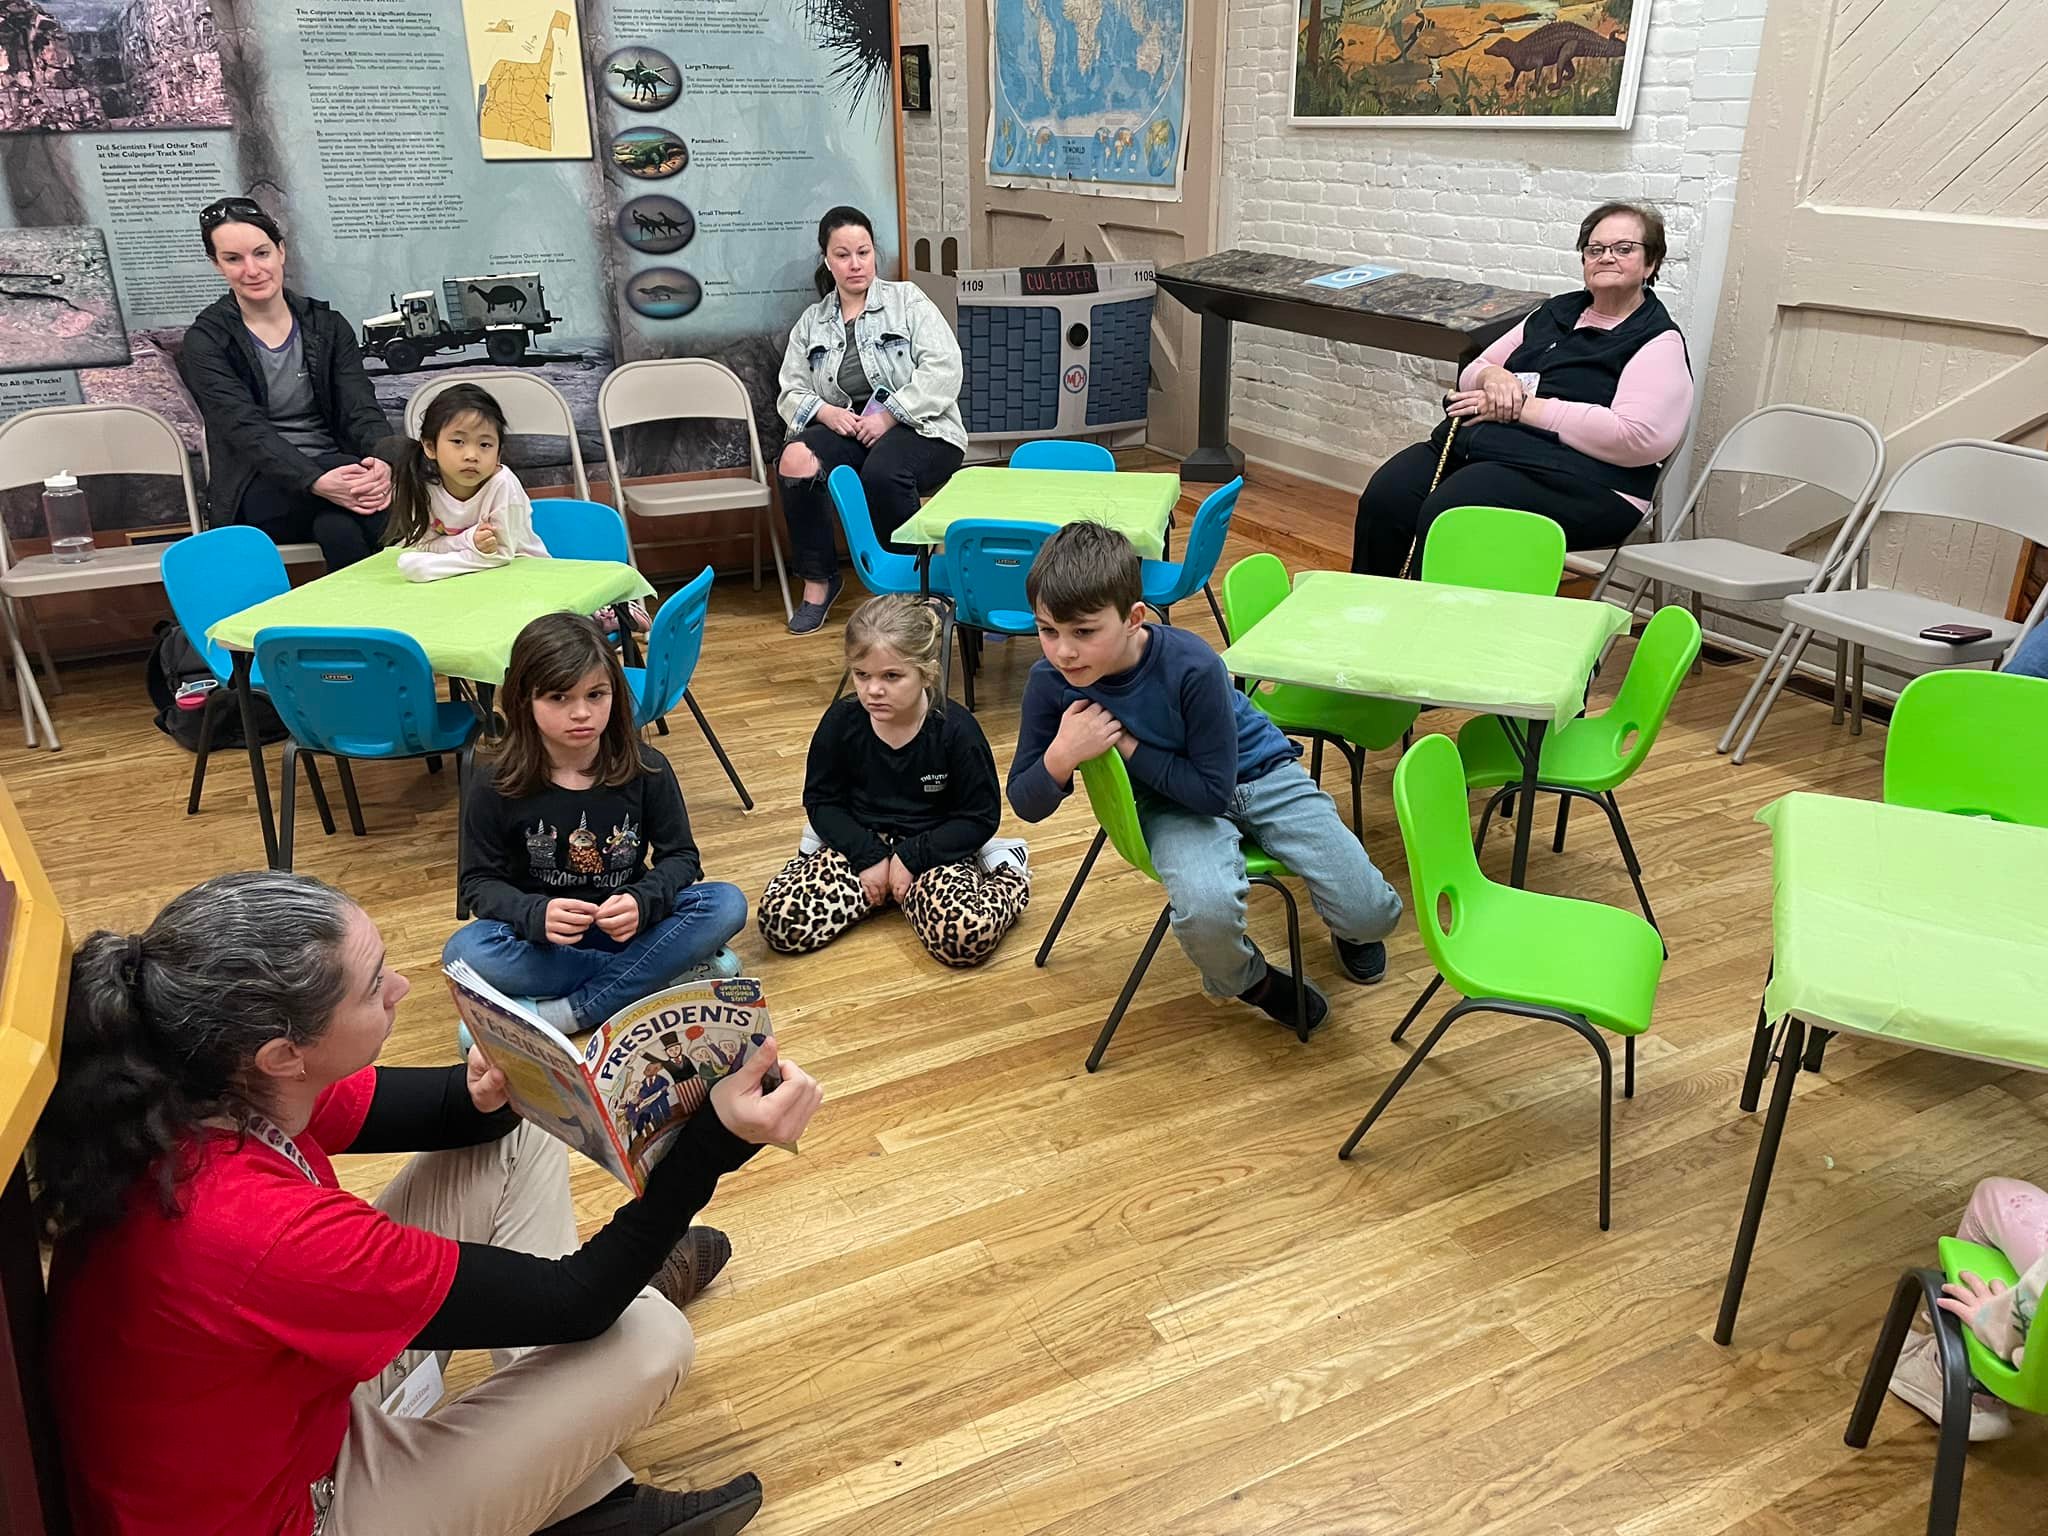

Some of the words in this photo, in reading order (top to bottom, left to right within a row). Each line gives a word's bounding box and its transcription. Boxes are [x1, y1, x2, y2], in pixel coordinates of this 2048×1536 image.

[1026, 270, 1092, 290] CULPEPER
[1134, 270, 1154, 282] 1109
[961, 280, 984, 292] 1109
[600, 1005, 753, 1080] PRESIDENTS
